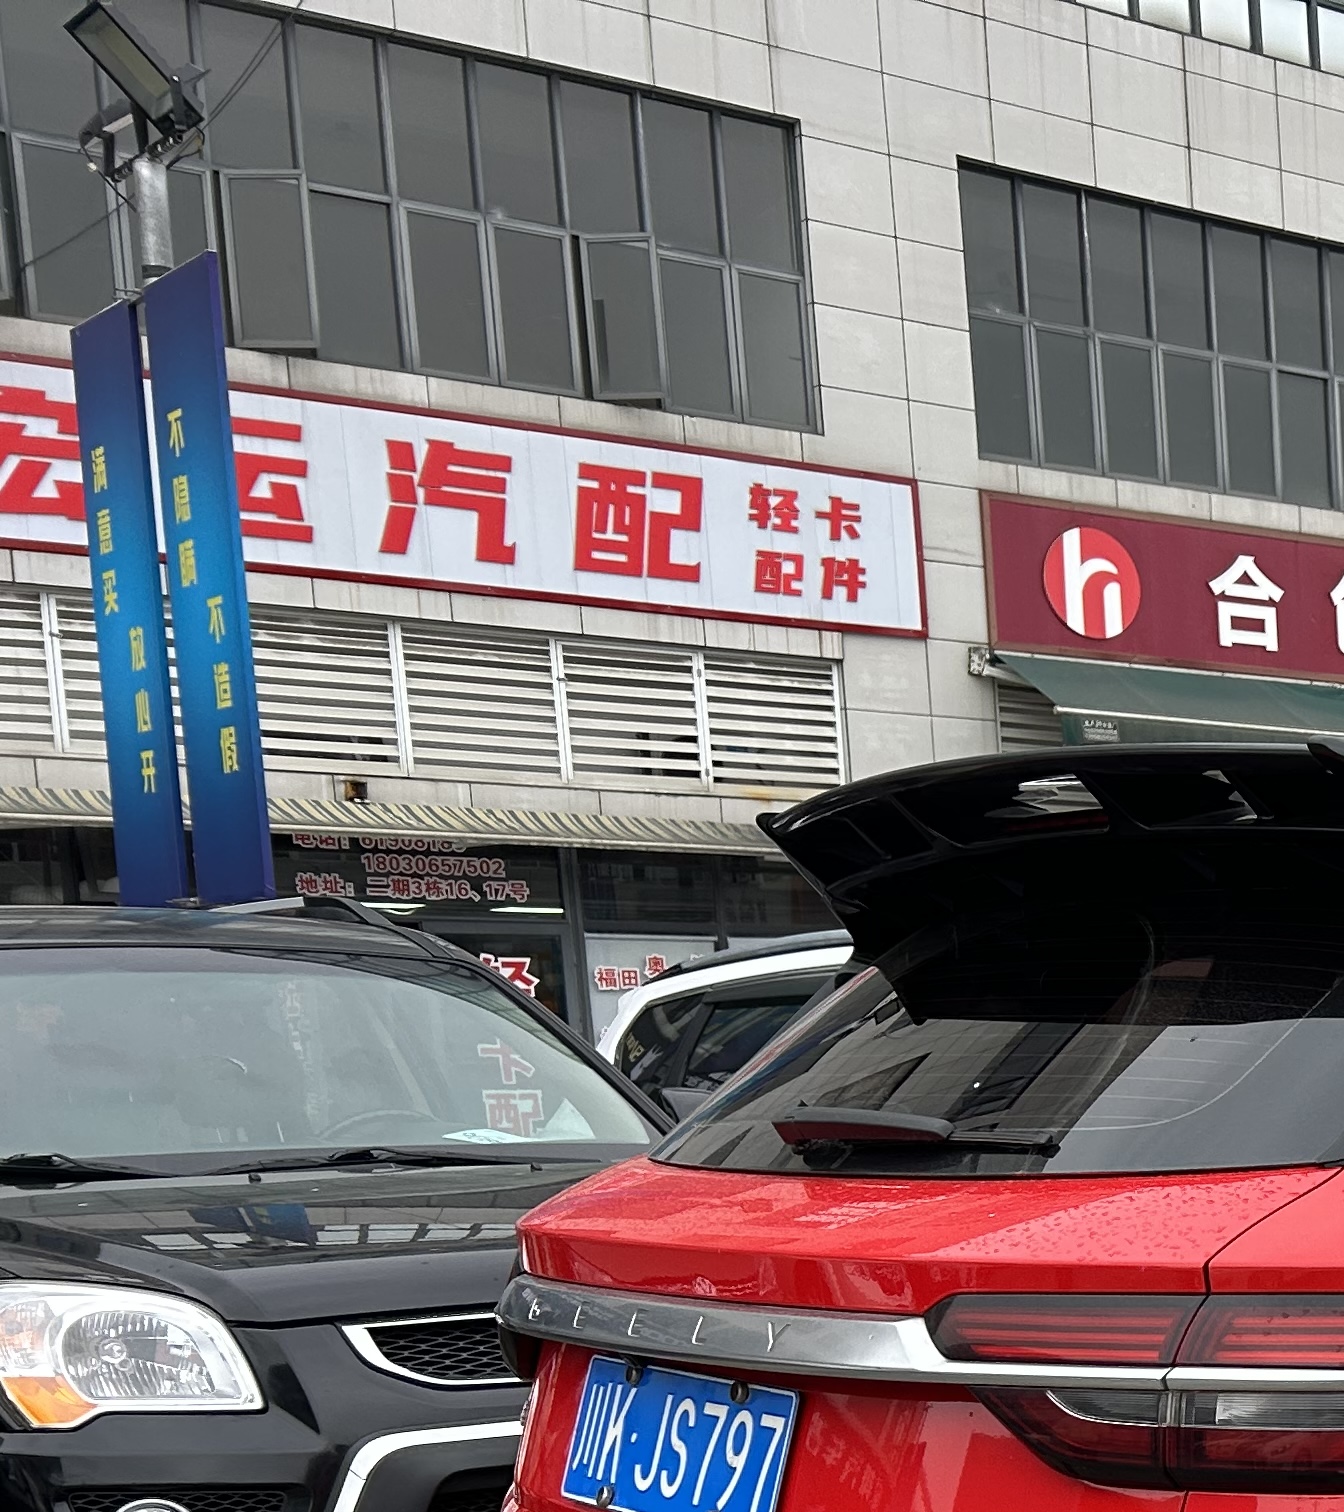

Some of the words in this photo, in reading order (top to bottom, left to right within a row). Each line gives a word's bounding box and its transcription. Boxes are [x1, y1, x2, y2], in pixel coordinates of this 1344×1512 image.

[748, 482, 862, 541] 轻卡
[754, 549, 867, 602] 配件
[128, 626, 157, 794] 放心开
[361, 854, 506, 878] 18030657502
[595, 965, 640, 990] 福田
[528, 1298, 791, 1353] GEELY
